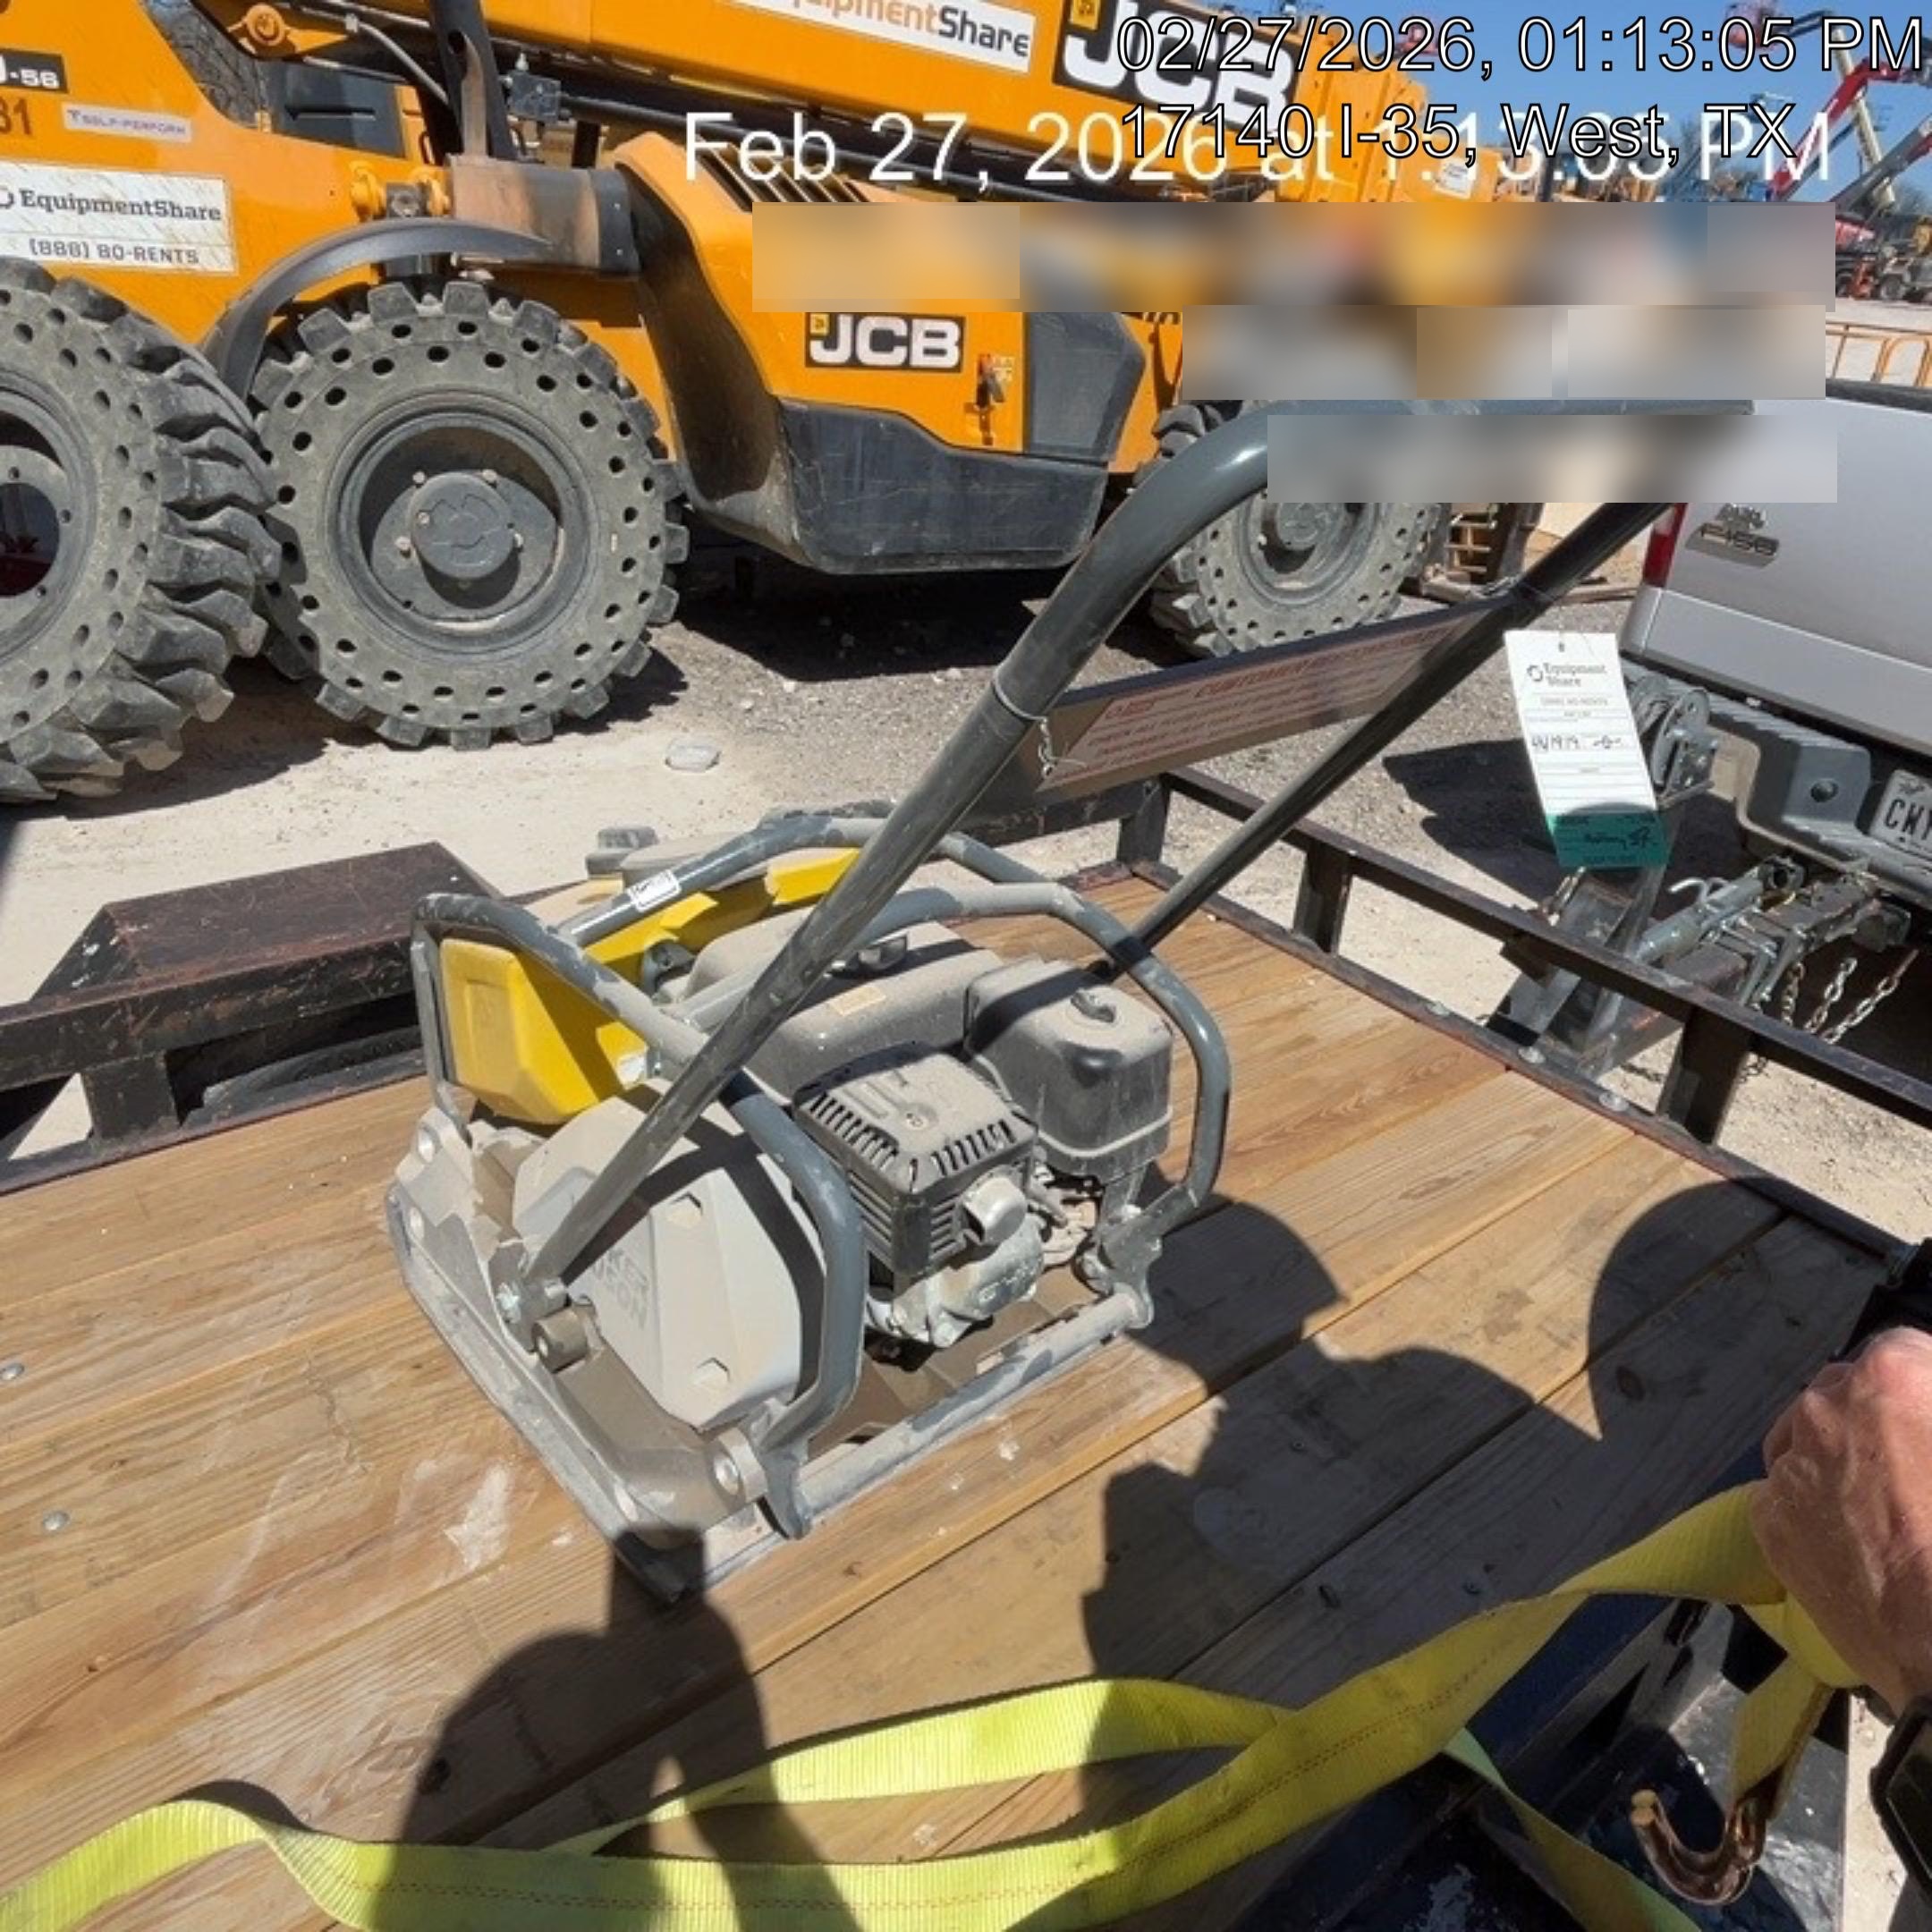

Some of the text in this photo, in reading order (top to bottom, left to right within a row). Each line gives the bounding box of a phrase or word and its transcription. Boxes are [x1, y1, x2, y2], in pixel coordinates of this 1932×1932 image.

[1063, 0, 1294, 133] JCB
[20, 189, 222, 222] EquipmentShare
[29, 238, 199, 265] (888) 80-RENTS
[809, 314, 961, 369] JCB
